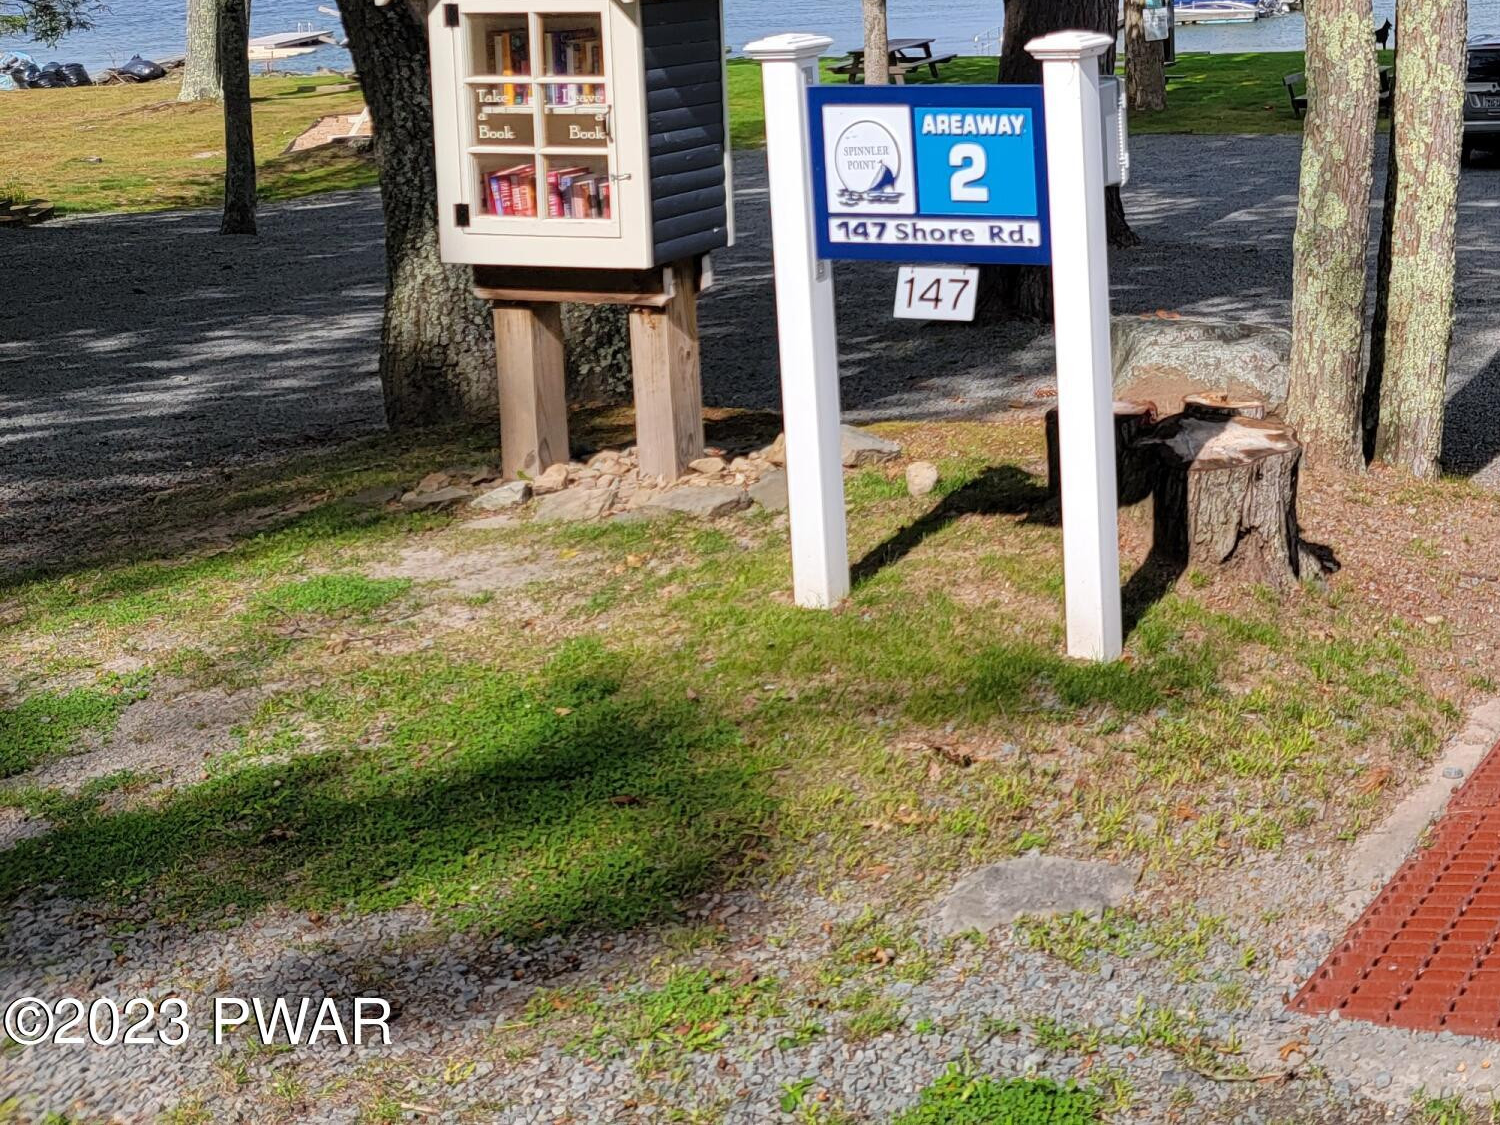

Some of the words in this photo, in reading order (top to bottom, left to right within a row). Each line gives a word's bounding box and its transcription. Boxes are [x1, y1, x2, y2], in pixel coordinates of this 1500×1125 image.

[476, 89, 510, 103] Take
[478, 124, 516, 139] Book
[568, 124, 607, 140] Book
[922, 113, 1025, 137] AREAWAY
[843, 145, 890, 157] SPINNLER
[847, 159, 876, 171] POINT
[948, 142, 989, 202] 2
[836, 221, 888, 241] 147
[895, 223, 976, 244] Shore
[989, 225, 1034, 244] Rd.
[903, 277, 970, 311] 147
